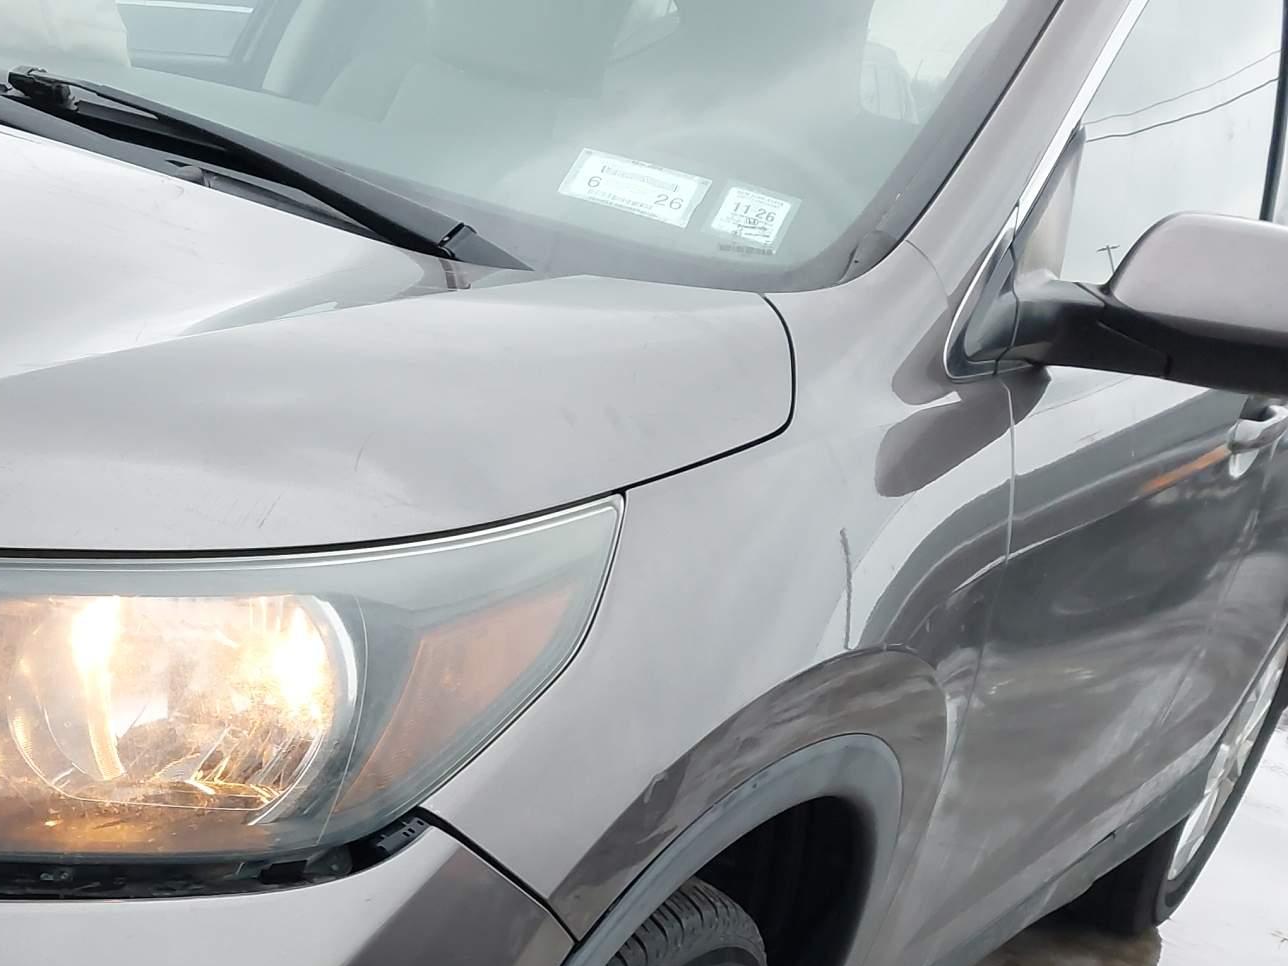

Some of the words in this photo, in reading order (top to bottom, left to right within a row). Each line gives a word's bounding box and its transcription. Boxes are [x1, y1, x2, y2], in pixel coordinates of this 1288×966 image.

[587, 176, 602, 187] 6
[654, 193, 683, 210] 26
[755, 208, 776, 222] 26
